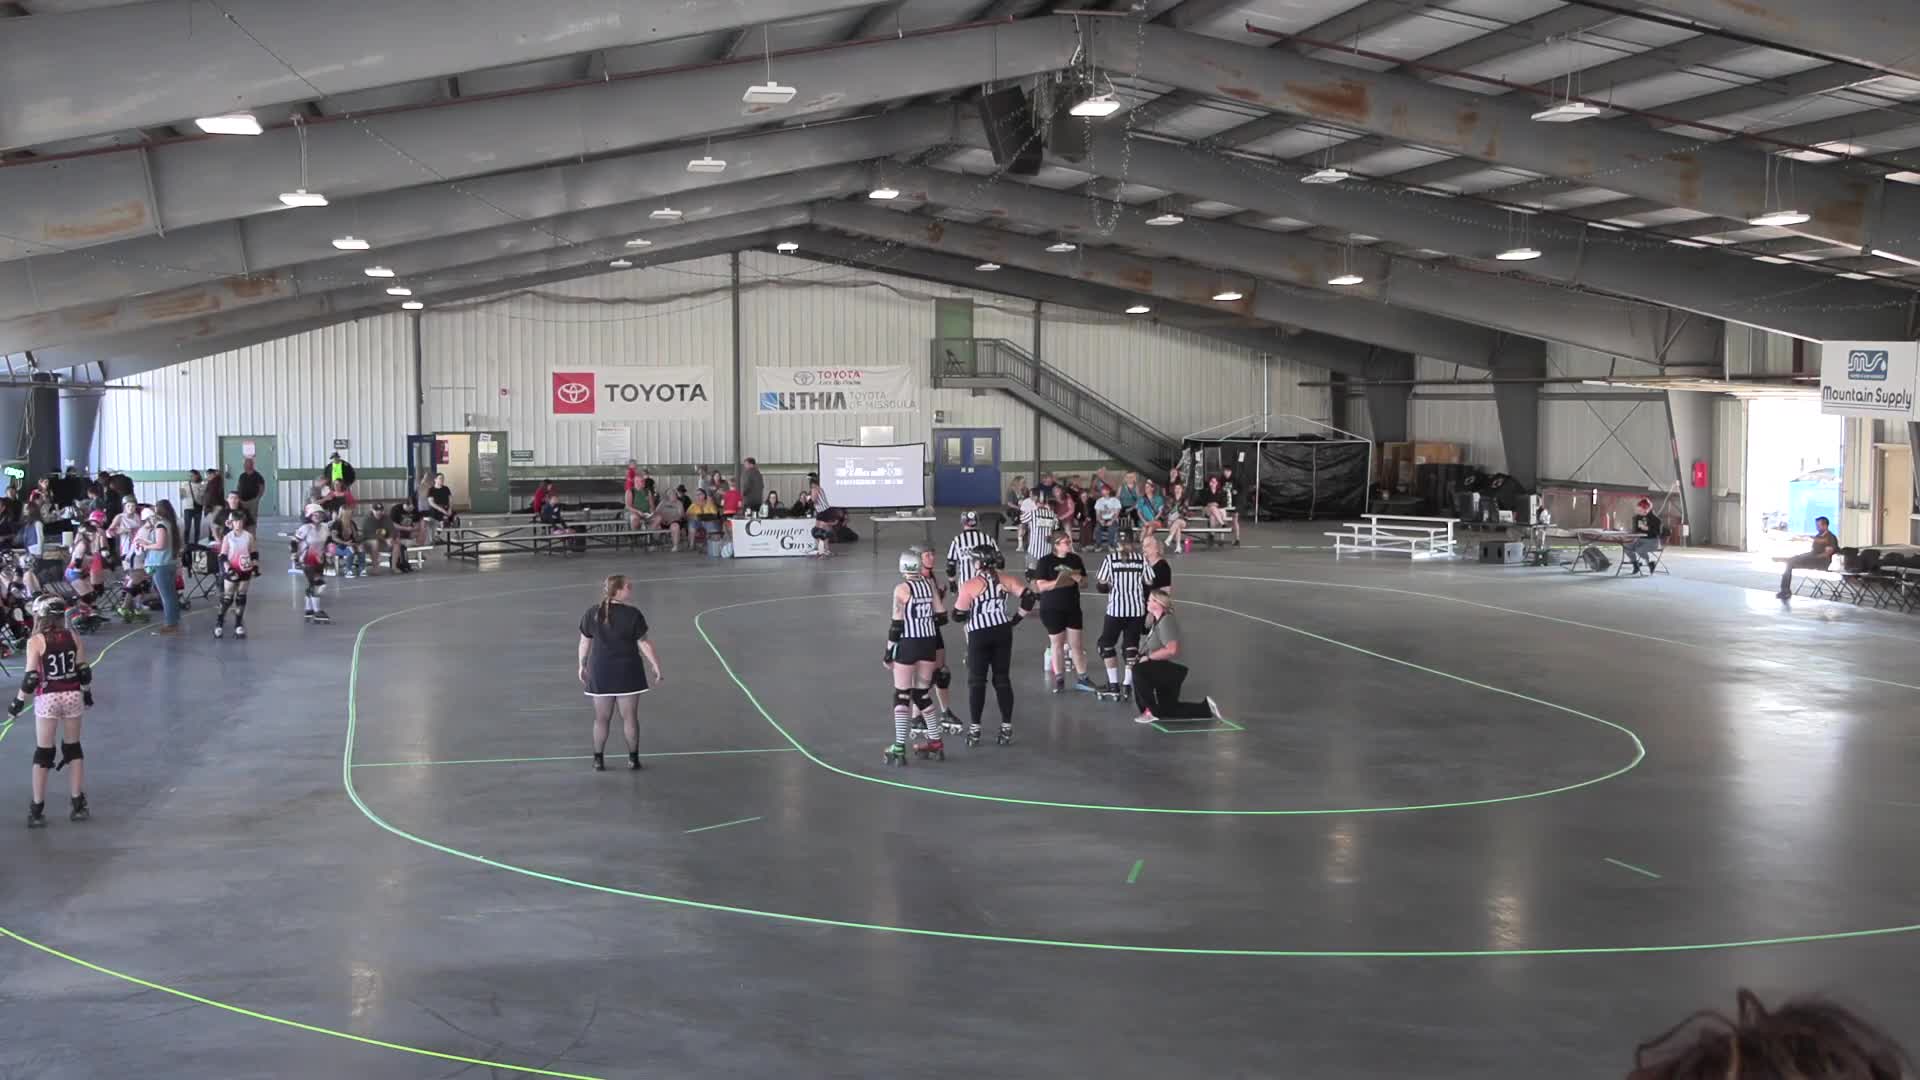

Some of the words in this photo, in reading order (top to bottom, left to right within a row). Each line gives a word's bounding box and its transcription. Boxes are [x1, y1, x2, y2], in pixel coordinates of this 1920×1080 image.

[817, 370, 861, 379] TOYOTA
[605, 383, 708, 402] TOYOTA
[778, 391, 848, 410] LITHIA
[850, 391, 886, 399] TOYOTA
[1823, 385, 1873, 403] Mountain
[1875, 387, 1912, 409] Supply
[745, 520, 804, 539] Computer
[48, 650, 75, 675] 313
